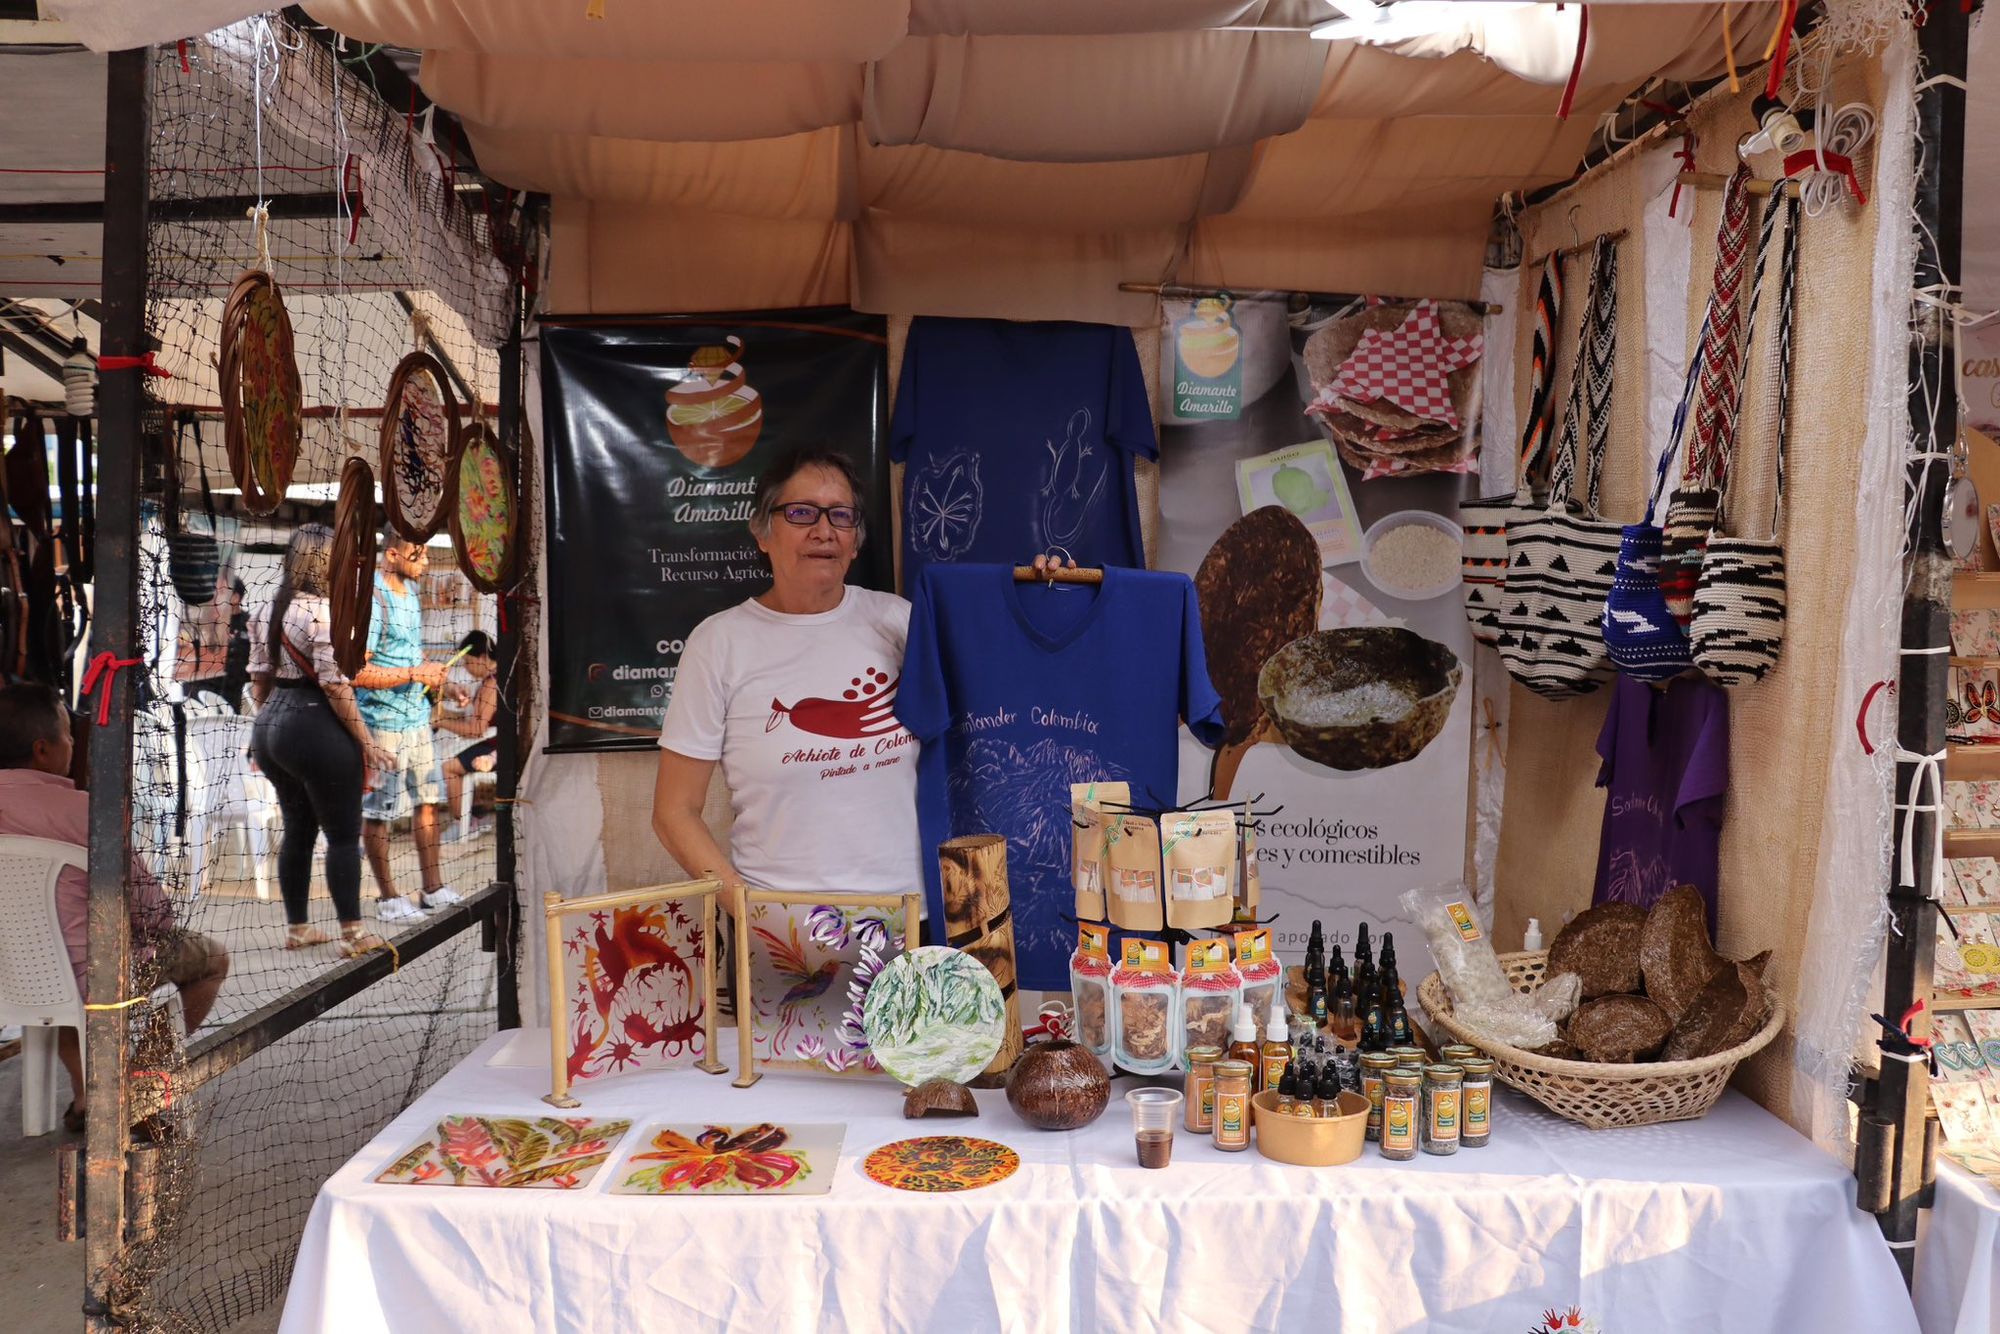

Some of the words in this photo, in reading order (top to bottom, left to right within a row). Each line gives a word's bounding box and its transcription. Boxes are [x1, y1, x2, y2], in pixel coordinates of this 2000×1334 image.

[1177, 381, 1237, 397] Diamante
[1180, 398, 1233, 414] Amarillo
[667, 476, 757, 497] Diamant
[647, 546, 757, 563] Transformació
[661, 567, 718, 582] Recurso
[1031, 706, 1099, 735] Colombia
[782, 747, 841, 764] Achiote
[850, 743, 866, 759] de
[875, 733, 919, 755] Colom
[820, 764, 858, 780] Pintado
[1271, 817, 1378, 845] ecológicos
[1282, 848, 1295, 869] y
[1299, 844, 1421, 866] comestibles
[1278, 930, 1350, 946] apoado
